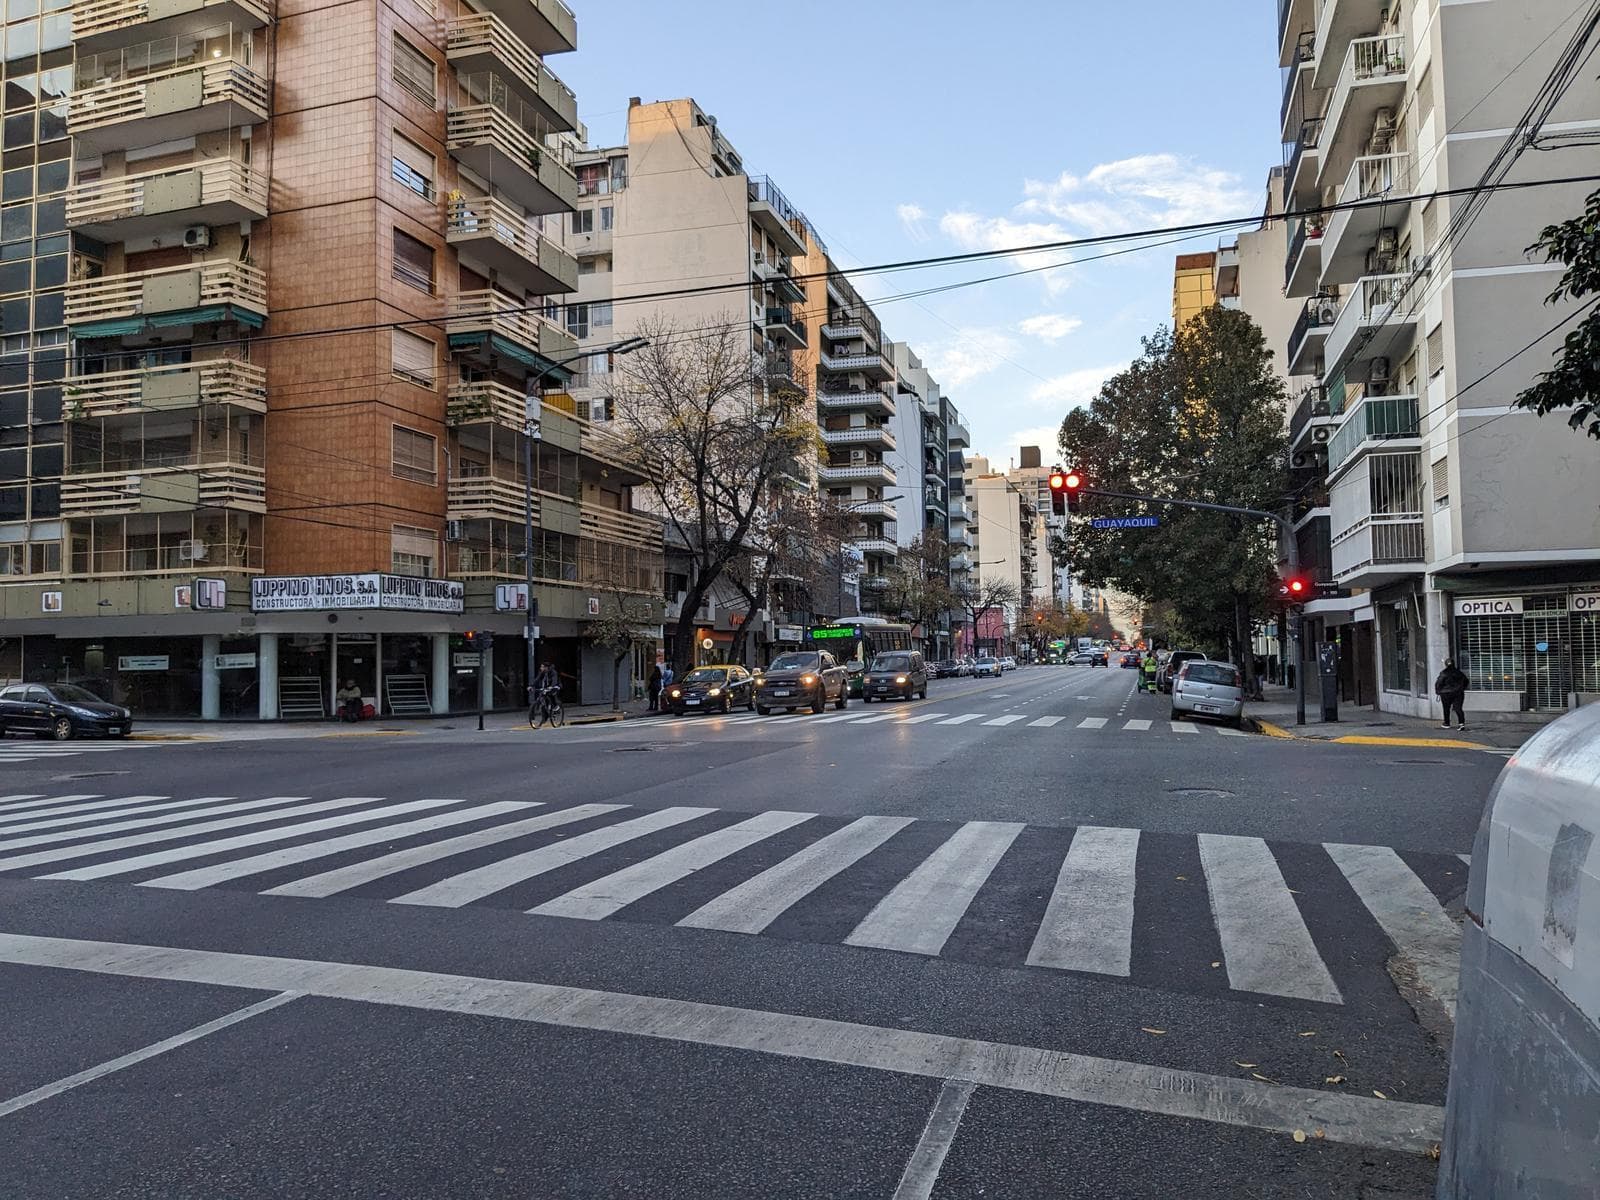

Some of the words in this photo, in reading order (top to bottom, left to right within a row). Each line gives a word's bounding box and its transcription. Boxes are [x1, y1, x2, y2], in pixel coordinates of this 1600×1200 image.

[1094, 518, 1156, 528] GUAYAQUIL
[254, 579, 309, 597] LUPPINO
[316, 577, 355, 595] HNOS.
[357, 580, 377, 594] S.A.
[383, 576, 421, 597] LUPPINO
[256, 598, 313, 608] CONSTRUCTORA
[322, 595, 375, 606] INMOBILIARIA
[1462, 602, 1513, 614] OPTICA
